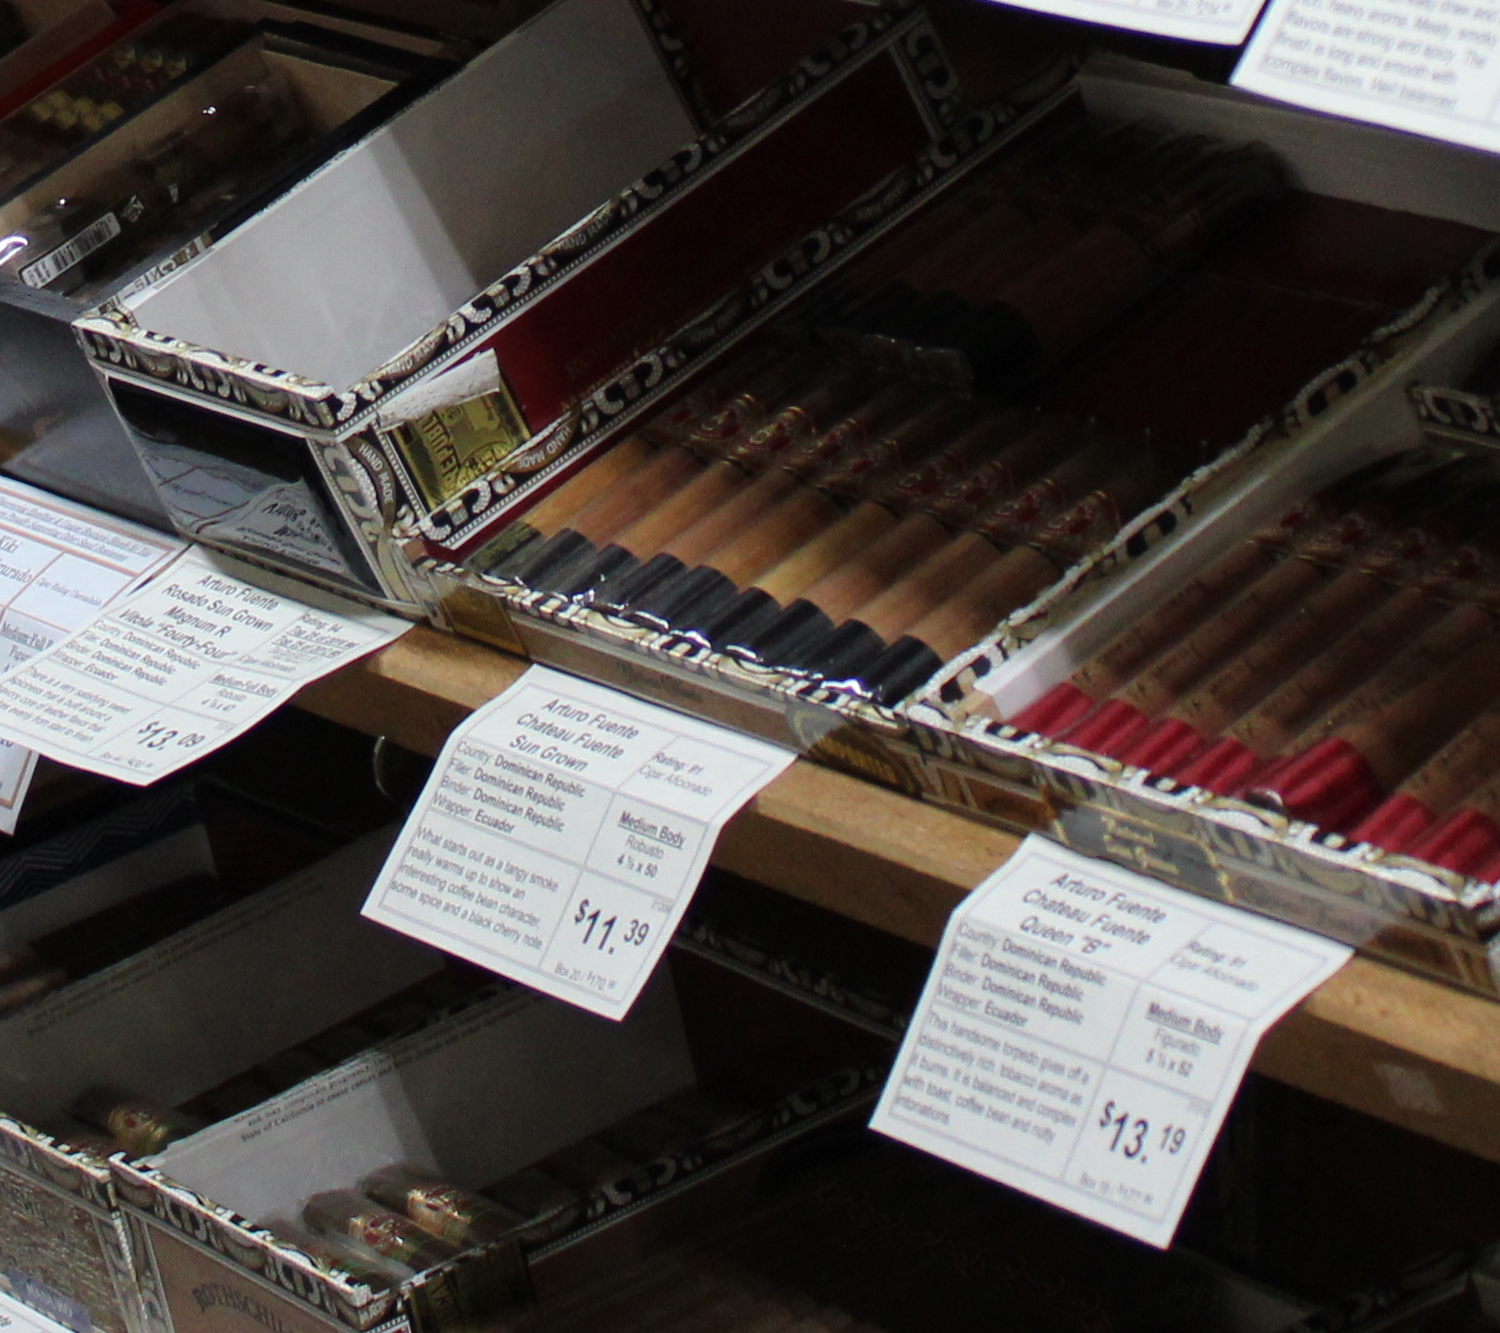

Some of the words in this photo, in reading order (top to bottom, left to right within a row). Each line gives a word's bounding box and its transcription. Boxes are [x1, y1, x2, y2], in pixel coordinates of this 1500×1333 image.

[357, 442, 384, 474] HAND
[377, 472, 395, 504] MADE
[161, 583, 209, 607] Rosado
[205, 598, 234, 617] Sun
[231, 608, 274, 631] Grown
[196, 573, 238, 596] Arturo
[235, 586, 283, 610] Fuente
[118, 608, 154, 628] Vitola
[163, 605, 217, 632] Magnum
[213, 624, 232, 638] R
[137, 720, 205, 751] $13.09
[515, 712, 574, 742] Chateau
[572, 731, 624, 759] Fuente
[541, 698, 590, 722] Arturo
[587, 712, 639, 739] Fuente
[508, 733, 541, 754] Sun
[539, 745, 588, 771] Grown
[493, 753, 544, 782] Dominican
[543, 771, 585, 798] Republic
[473, 807, 515, 833] Ecuador
[617, 810, 658, 839] Medium
[654, 824, 685, 850] Body
[441, 838, 468, 856] starts
[467, 848, 485, 863] out
[482, 854, 496, 868] as
[494, 859, 504, 871] a
[503, 860, 529, 883] tangy
[528, 872, 559, 892] smoke
[624, 833, 664, 860] Robusto
[398, 862, 447, 893] interesting
[446, 882, 475, 901] coffee
[474, 890, 499, 910] bean
[406, 844, 435, 866] really
[434, 856, 464, 876] warms
[464, 869, 478, 883] up
[476, 870, 489, 886] to
[487, 876, 512, 895] show
[511, 887, 526, 900] an
[390, 879, 418, 899] some
[417, 891, 443, 909] spice
[441, 901, 462, 917] and
[459, 908, 469, 920] a
[467, 909, 493, 929] black
[491, 921, 522, 944] cherry
[1022, 888, 1090, 923] Chateau
[1090, 912, 1151, 945] Fuente
[1049, 872, 1106, 901] Arturo
[1105, 891, 1166, 923] Fuente
[573, 898, 649, 954] $11.39
[1019, 915, 1074, 944] Queen
[1080, 934, 1112, 954] "B"
[1098, 1100, 1185, 1162] $13.19
